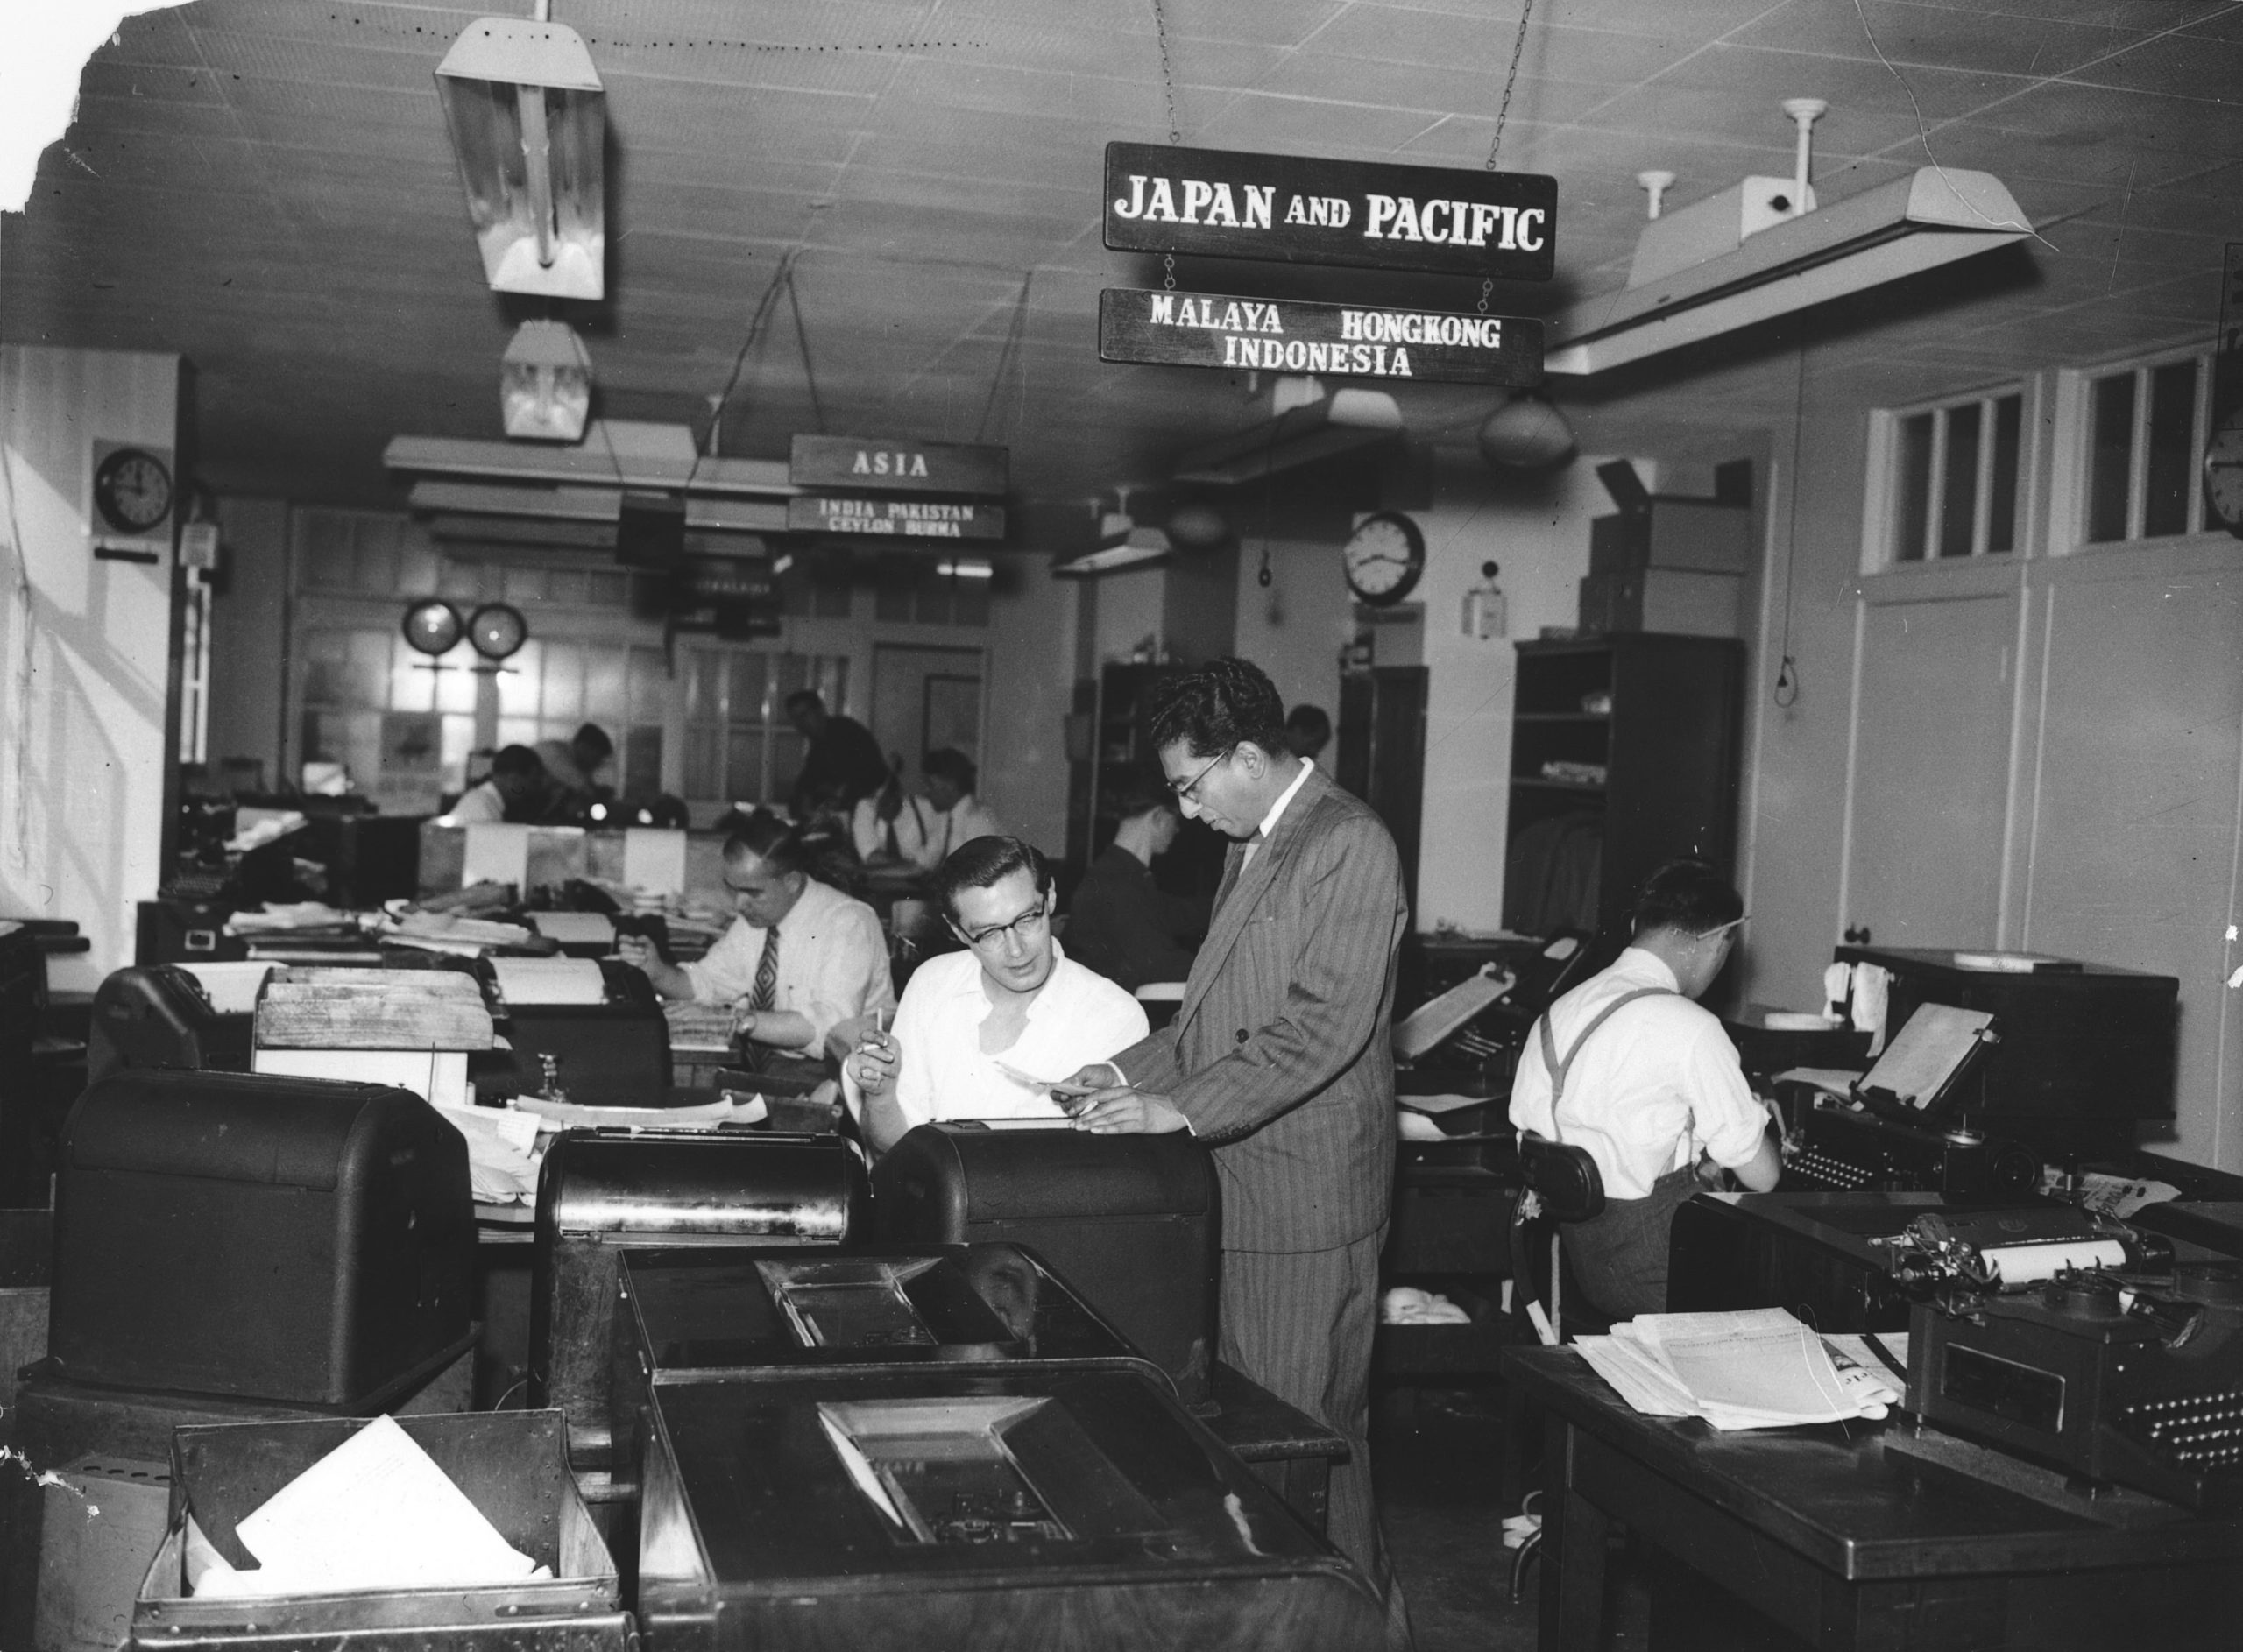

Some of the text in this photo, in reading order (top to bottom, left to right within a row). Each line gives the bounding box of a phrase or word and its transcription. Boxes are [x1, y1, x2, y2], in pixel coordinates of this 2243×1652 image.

[1114, 175, 1544, 251] JAPAN AND PACIFIC
[1150, 295, 1500, 348] MALAYA HONGKONG
[1223, 336, 1412, 376] INDONESIA
[853, 451, 927, 476] ASIA
[819, 499, 973, 522] INDIA PAKISTAN
[827, 515, 961, 538] CEYLON BURMA
